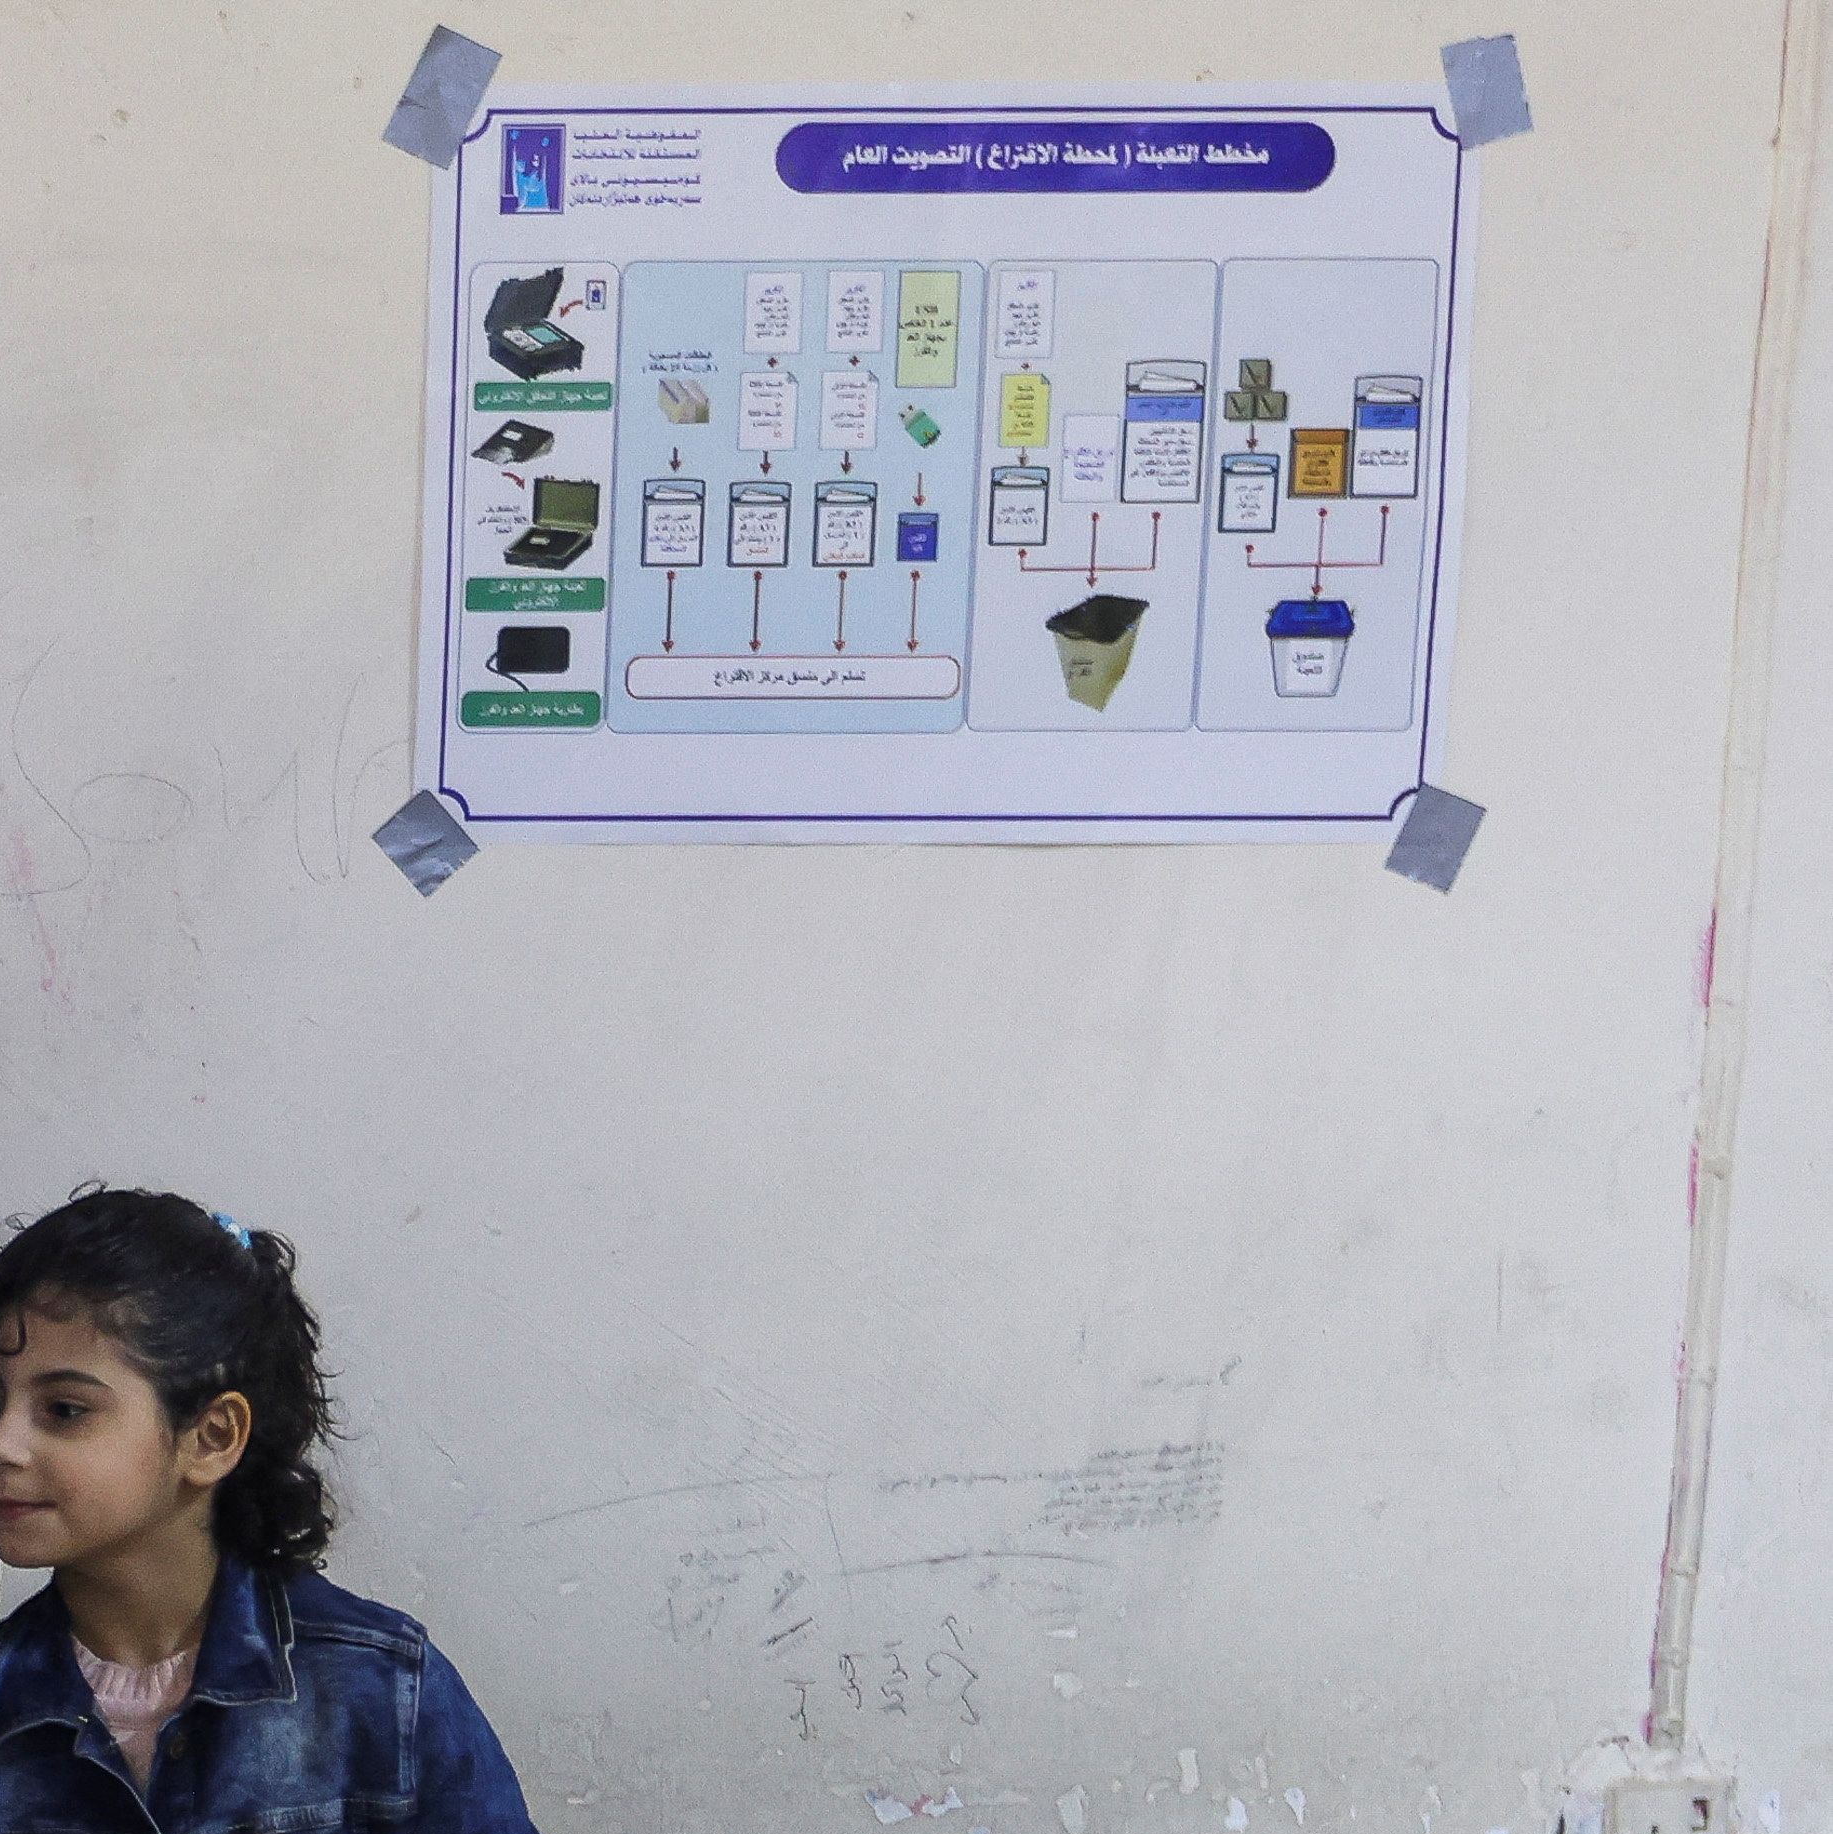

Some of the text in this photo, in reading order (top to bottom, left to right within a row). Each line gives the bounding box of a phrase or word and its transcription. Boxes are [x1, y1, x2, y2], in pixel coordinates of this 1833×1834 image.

[842, 145, 888, 172] العام
[892, 144, 972, 171] التصويت
[987, 143, 1058, 171] الاقتراع
[1134, 143, 1200, 171] التعبئة
[1202, 144, 1270, 166] مخطط
